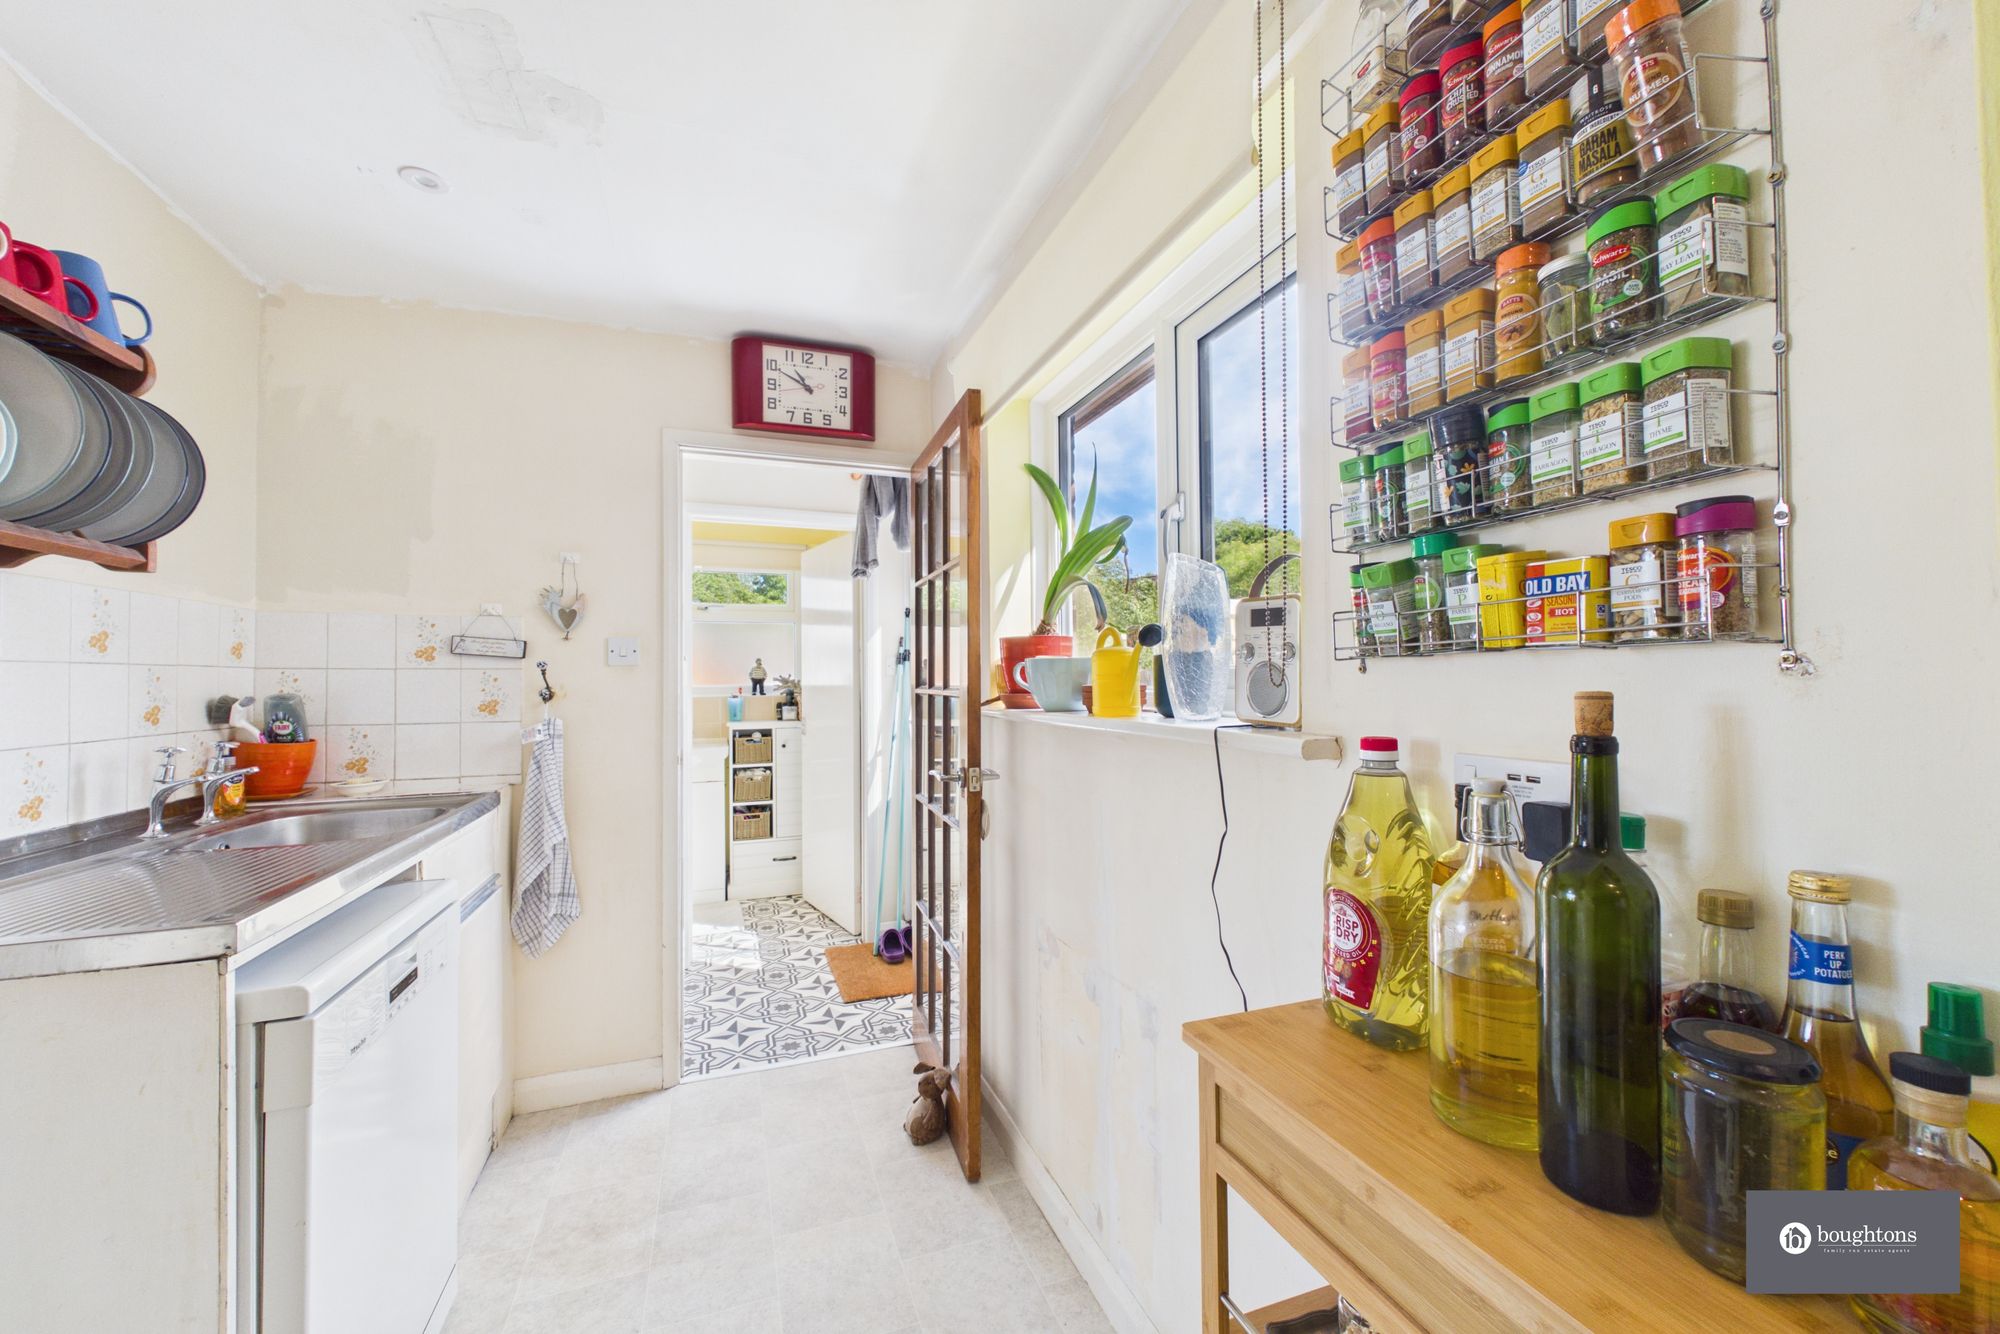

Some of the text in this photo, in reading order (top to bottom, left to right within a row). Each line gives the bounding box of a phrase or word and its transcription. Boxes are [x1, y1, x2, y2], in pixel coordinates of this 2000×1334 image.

[1631, 60, 1655, 78] BTTS
[1629, 75, 1670, 104] NUMEG
[1580, 127, 1618, 158] GARAM
[1578, 142, 1621, 172] MASALA
[1670, 226, 1692, 242] TESCO
[1592, 246, 1628, 267] Schwartz
[785, 350, 794, 362] 11
[802, 352, 814, 365] 12
[766, 358, 848, 380] 10 2
[767, 378, 848, 399] 9 3
[767, 397, 848, 417] 8 4
[786, 410, 832, 426] 7 6 5
[1649, 425, 1673, 439] THYME
[1582, 441, 1617, 458] TARRAGON
[1535, 457, 1568, 471] TARRAGON
[1621, 566, 1643, 574] TESCO
[1526, 573, 1588, 597] OLD BAY
[1623, 593, 1643, 602] PODS
[1555, 608, 1575, 616] HOT
[1335, 914, 1359, 931] RISP
[1336, 926, 1359, 944] DRY
[1823, 950, 1845, 960] PERK
[1829, 960, 1842, 969] UP
